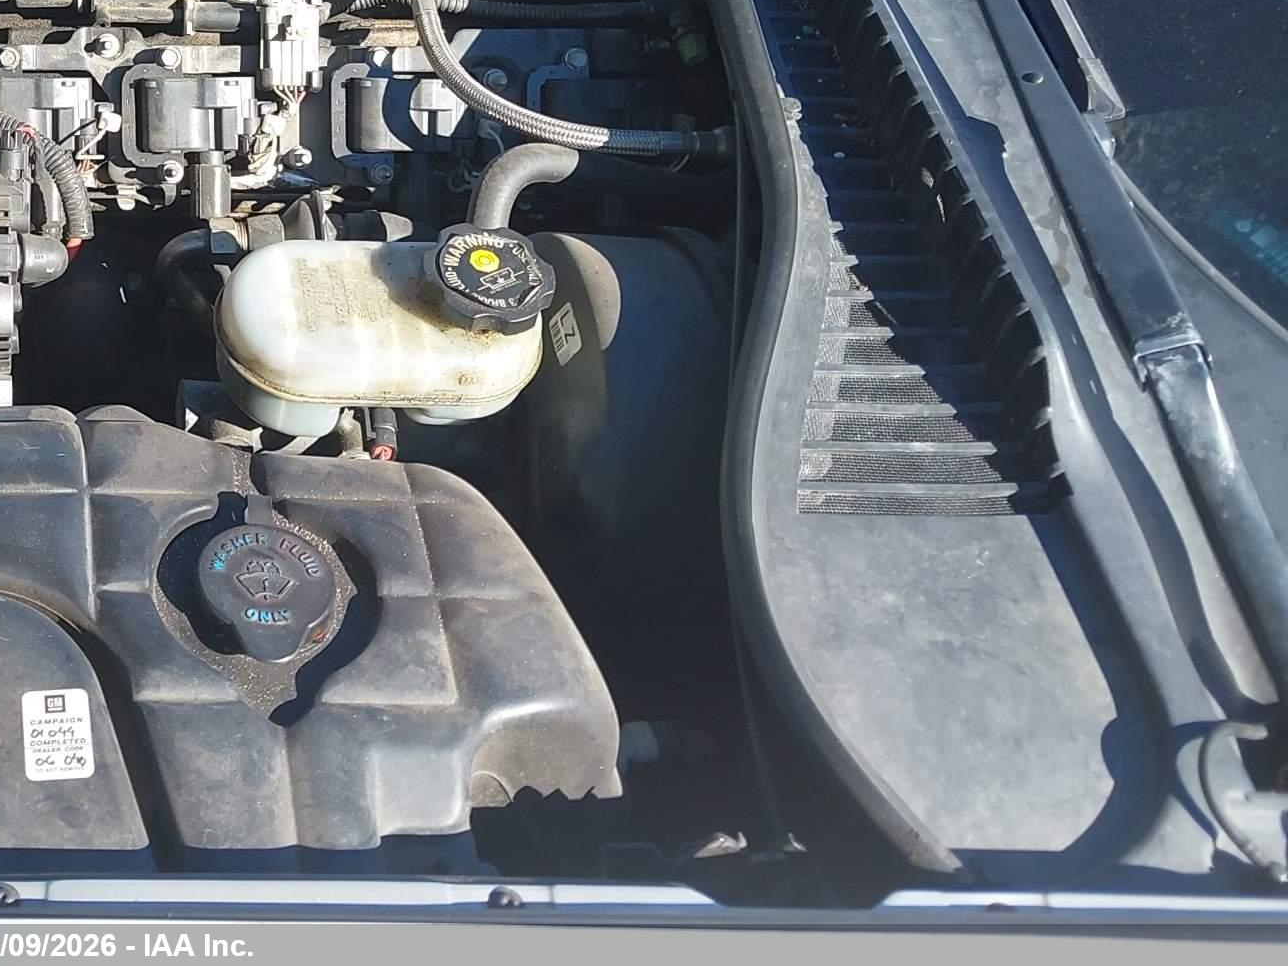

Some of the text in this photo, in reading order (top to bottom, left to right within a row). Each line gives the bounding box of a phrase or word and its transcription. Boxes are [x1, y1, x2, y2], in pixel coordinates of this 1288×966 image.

[444, 232, 505, 267] WARNING
[445, 271, 470, 293] LUID
[210, 532, 322, 579] WASHER FLUID
[244, 608, 290, 624] ONLY
[45, 695, 65, 710] GM
[30, 717, 84, 726] CAMPAIGN
[30, 737, 87, 747] COMPLETED
